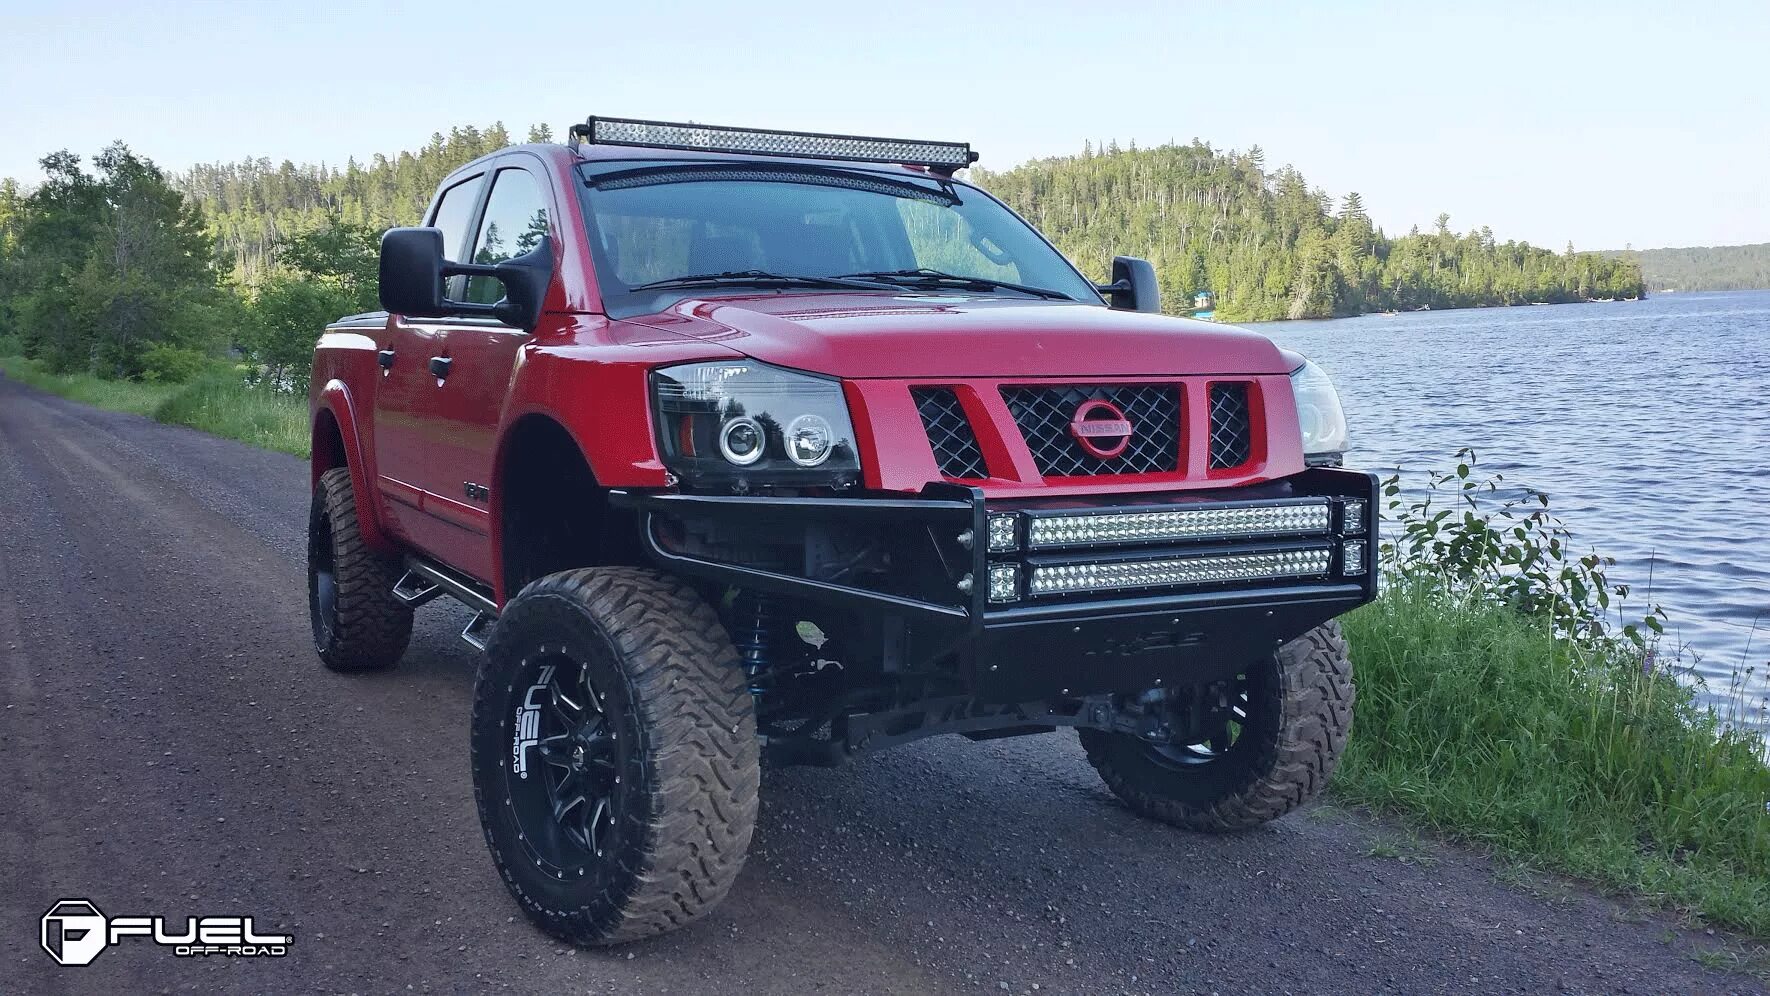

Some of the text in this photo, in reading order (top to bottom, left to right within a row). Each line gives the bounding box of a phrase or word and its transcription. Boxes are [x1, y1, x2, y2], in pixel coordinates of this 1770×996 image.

[1081, 423, 1128, 434] NISSAN
[513, 706, 523, 774] OFF-ROAD
[519, 665, 556, 773] FUEL
